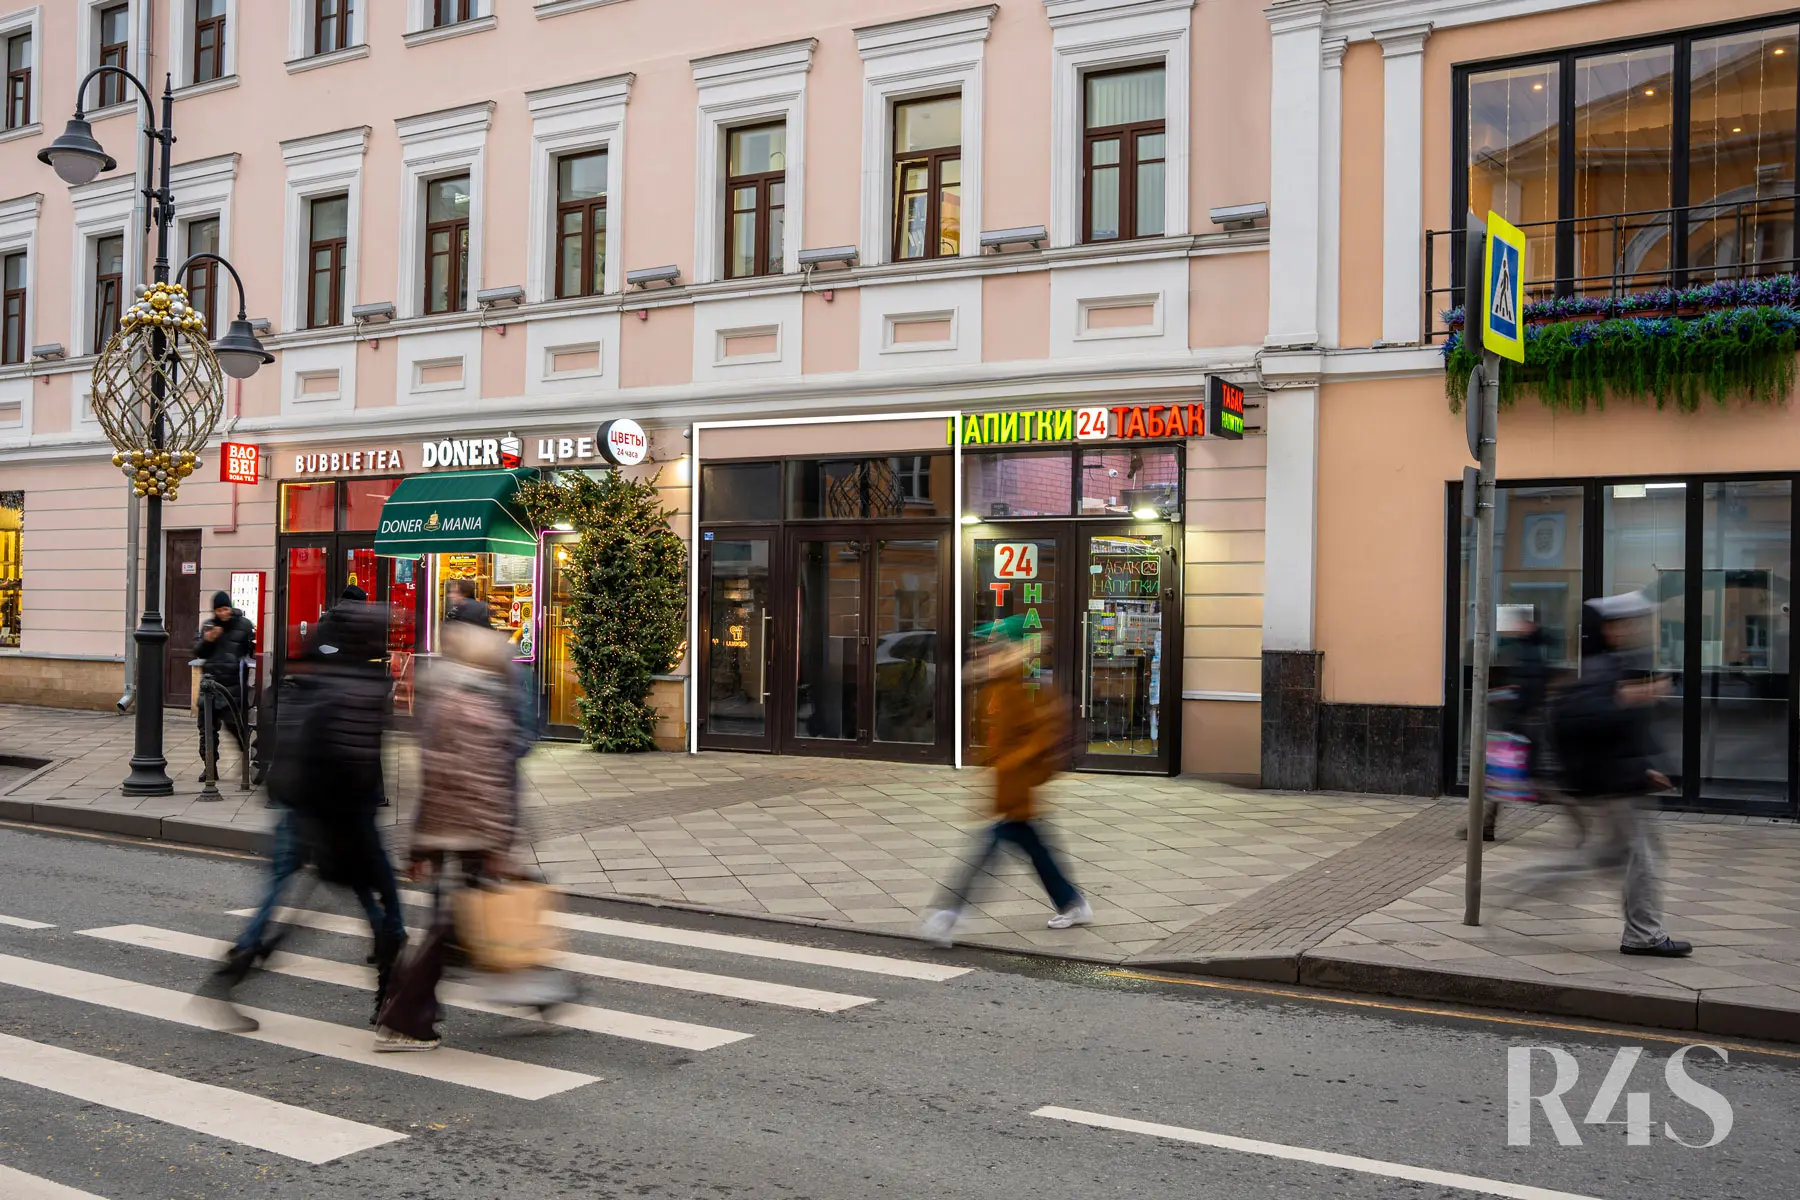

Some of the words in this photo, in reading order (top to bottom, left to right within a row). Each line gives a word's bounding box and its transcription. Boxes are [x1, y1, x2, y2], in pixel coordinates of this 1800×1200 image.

[1222, 383, 1244, 414] ТАБАК
[1078, 411, 1106, 436] 24
[1111, 403, 1204, 438] ТАБАК
[1221, 411, 1244, 434] НАПИТКИ
[610, 430, 644, 447] ЦВЕТЫ
[229, 445, 256, 460] BAO
[538, 437, 593, 463] ЦВЕ
[616, 447, 625, 456] 24
[624, 450, 639, 459] часа
[229, 458, 256, 475] BEI
[295, 451, 364, 473] BUBBLE
[367, 449, 402, 469] TEA
[381, 519, 422, 534] DONER
[441, 516, 482, 531] MANIA
[999, 545, 1033, 577] 24
[1143, 562, 1157, 574] 24
[1093, 580, 1159, 593] НАПИТКИ
